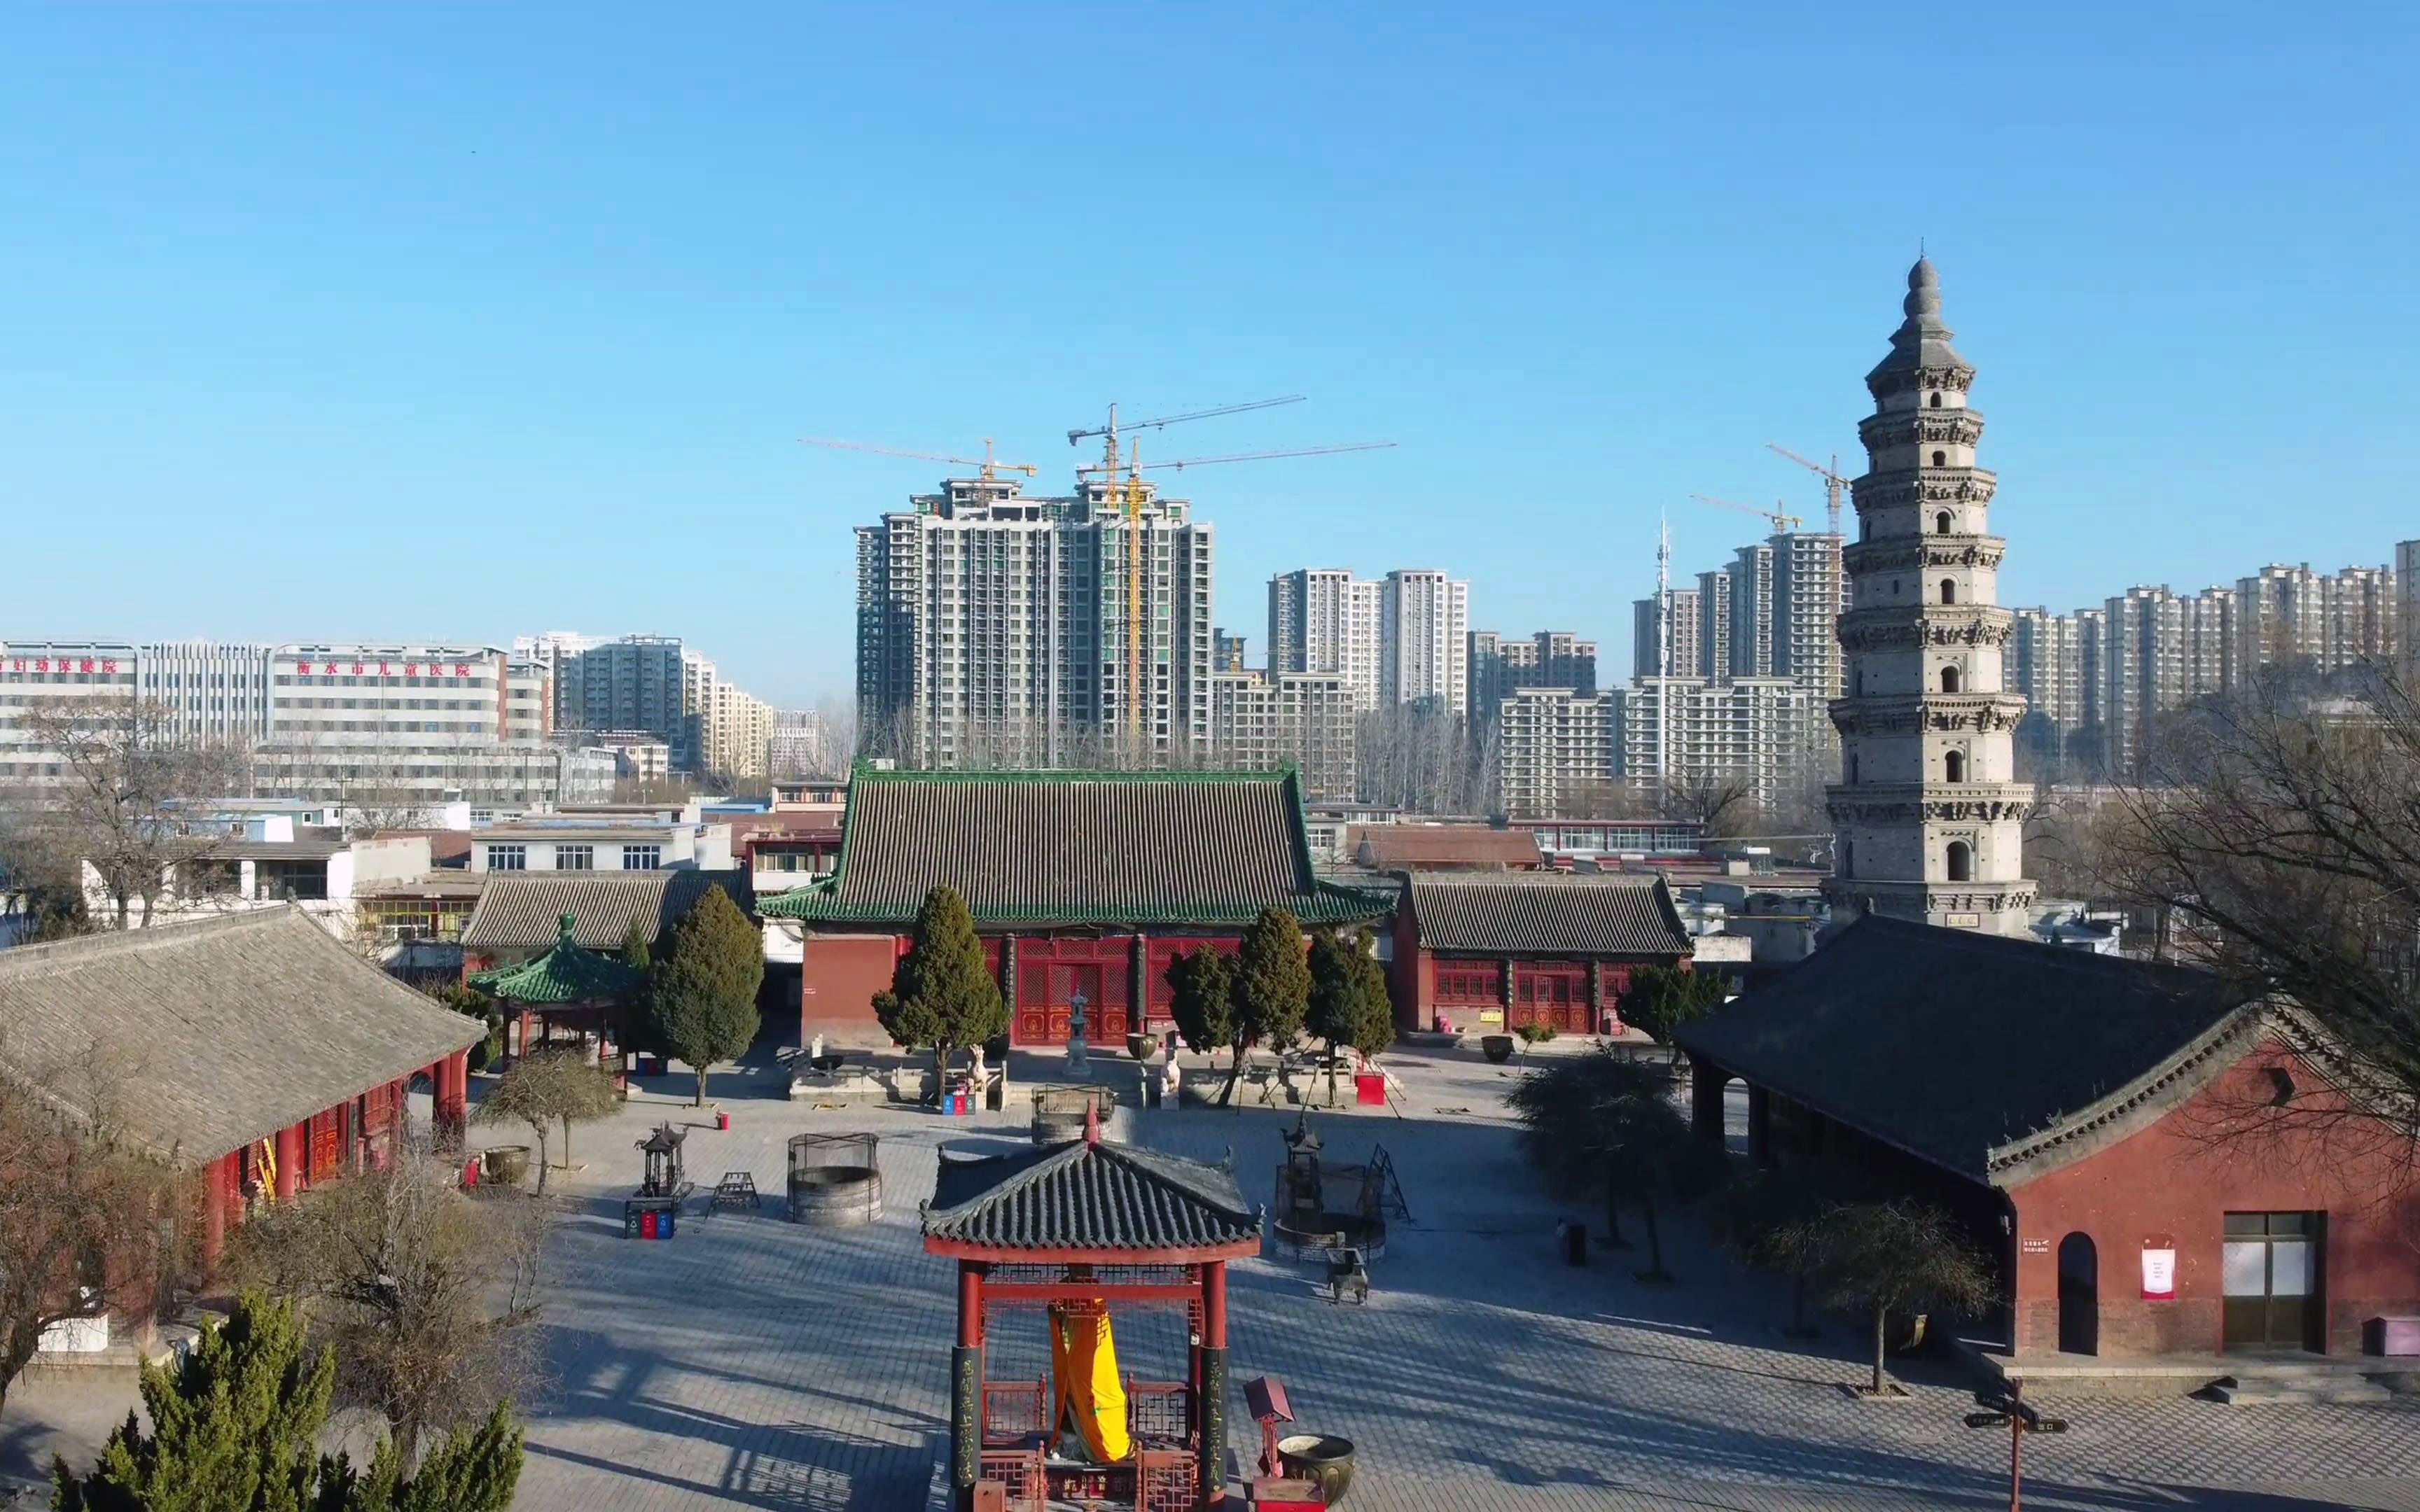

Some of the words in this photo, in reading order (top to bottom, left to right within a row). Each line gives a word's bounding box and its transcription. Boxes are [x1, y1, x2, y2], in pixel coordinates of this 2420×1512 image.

[0, 659, 118, 673] 妇幼保健院
[297, 661, 470, 677] 衡水市儿童医院
